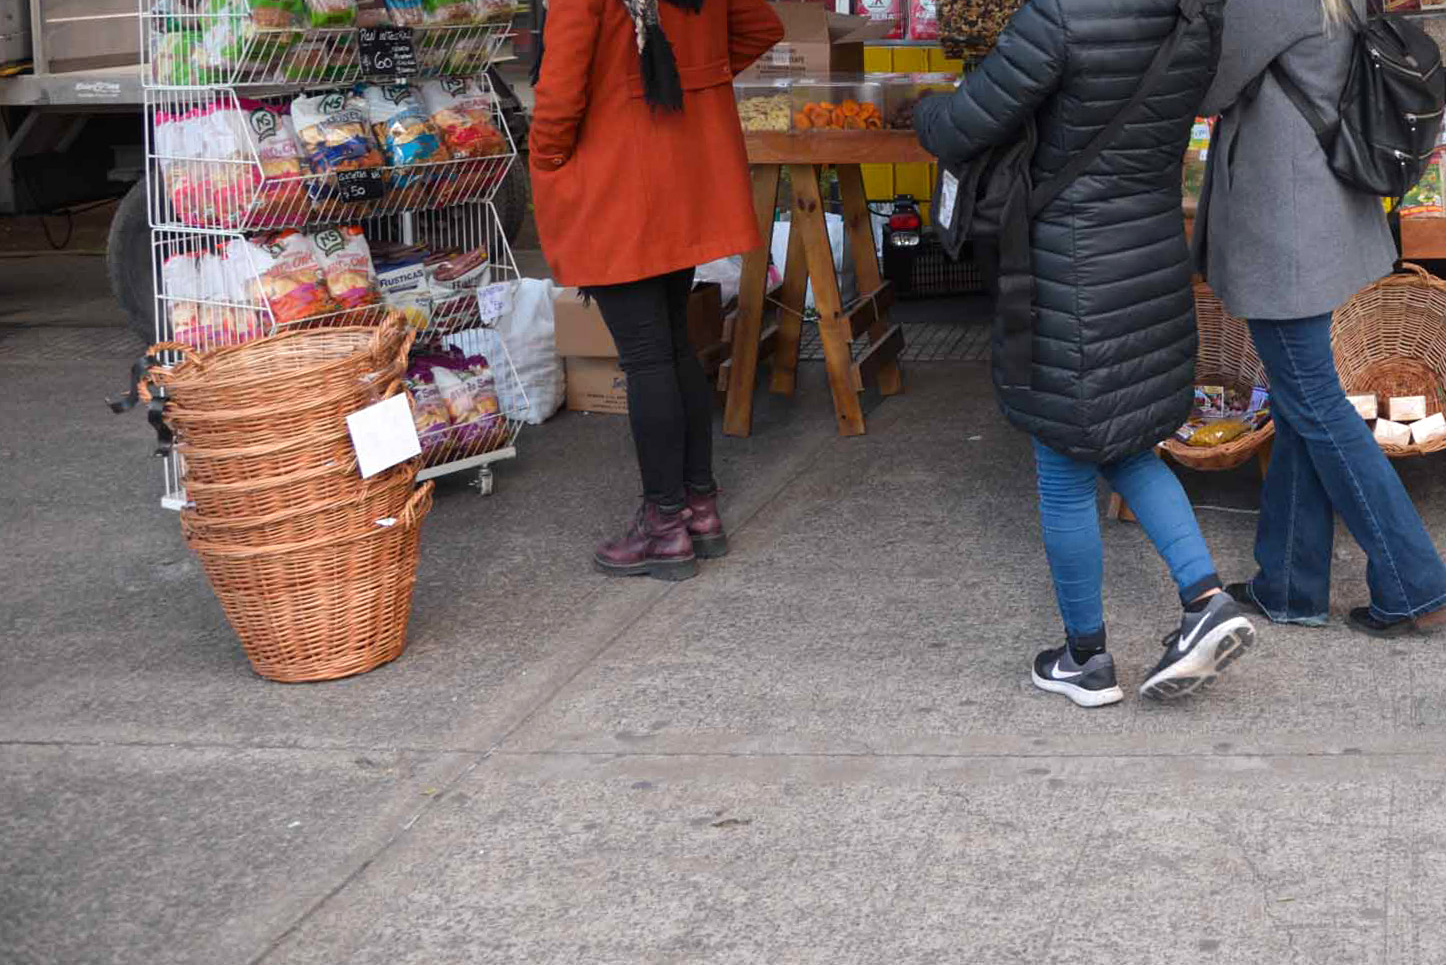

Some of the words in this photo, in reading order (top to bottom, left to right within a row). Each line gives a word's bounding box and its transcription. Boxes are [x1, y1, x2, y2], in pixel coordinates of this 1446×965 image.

[323, 96, 343, 111] NS
[321, 229, 339, 246] NS
[380, 268, 426, 289] RUSTICAS
